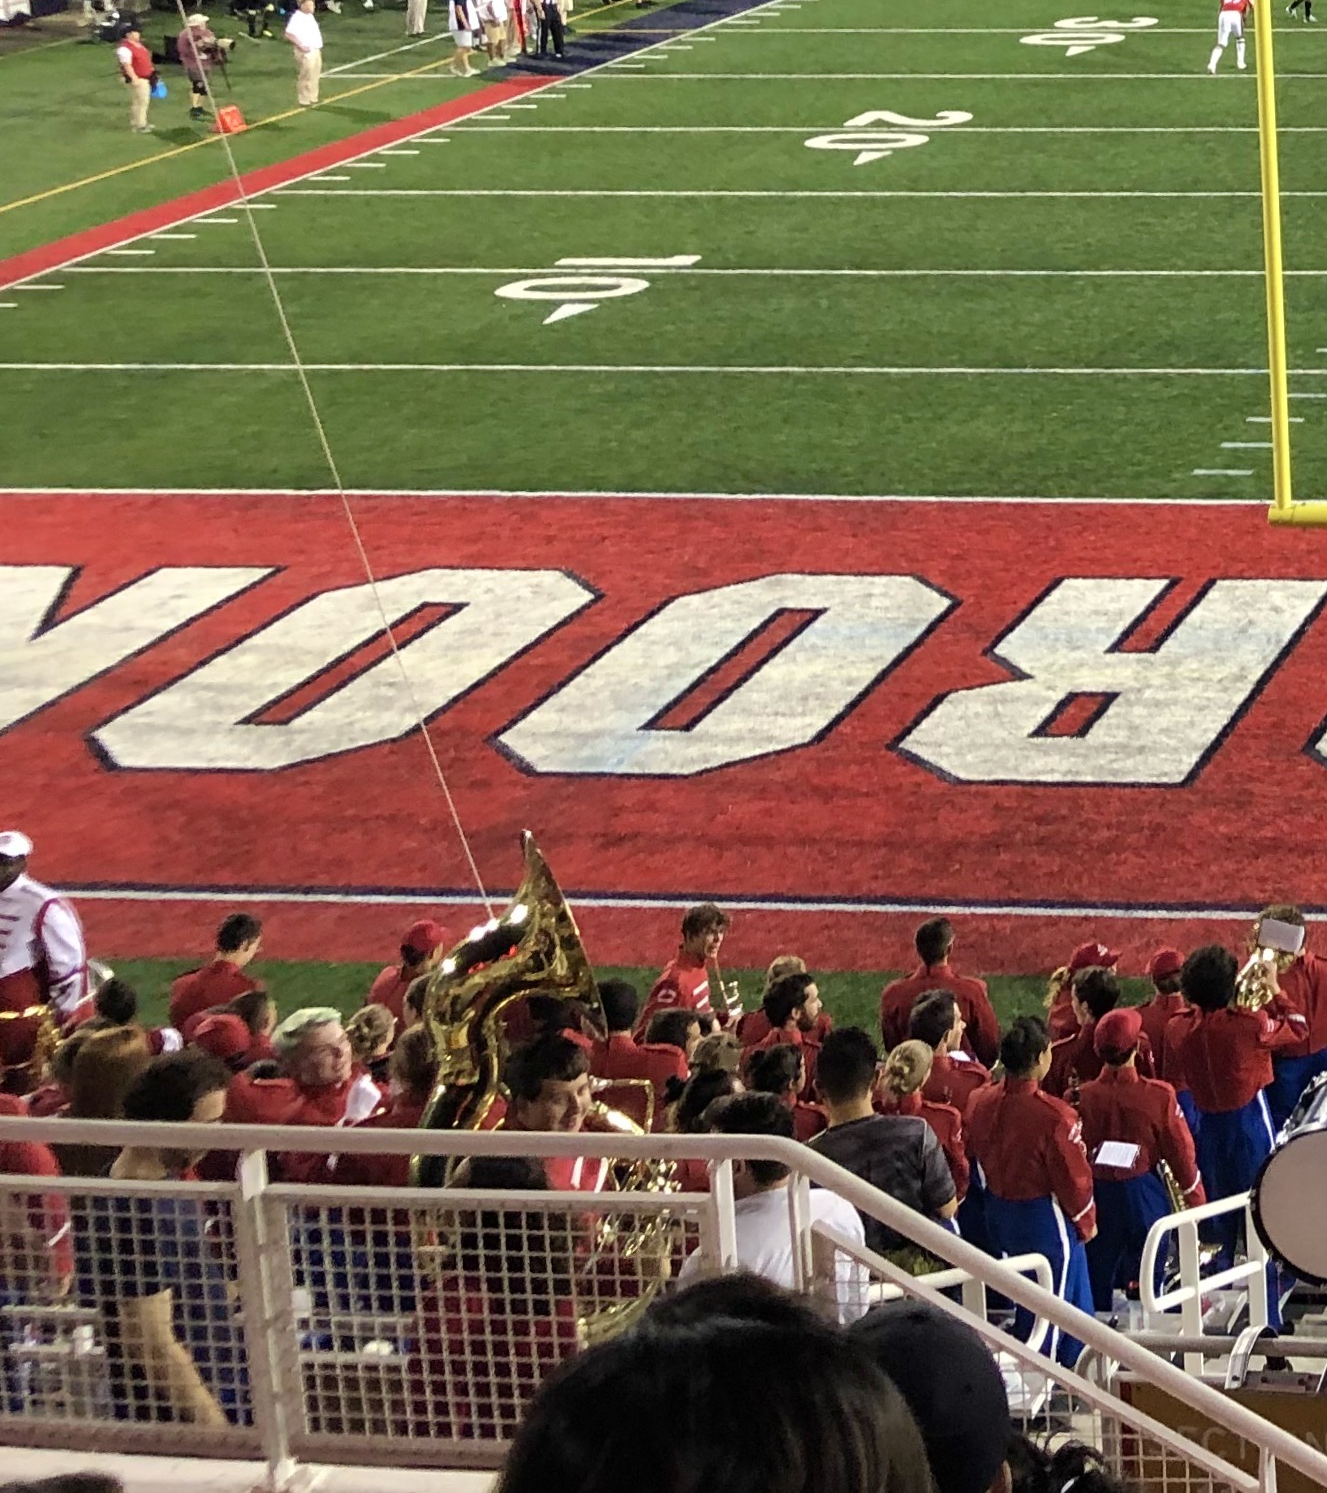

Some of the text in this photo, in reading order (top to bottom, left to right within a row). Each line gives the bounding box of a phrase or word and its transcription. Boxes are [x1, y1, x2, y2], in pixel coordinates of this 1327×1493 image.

[1019, 15, 1159, 47] 30
[804, 109, 974, 150] 20
[494, 254, 702, 300] 10
